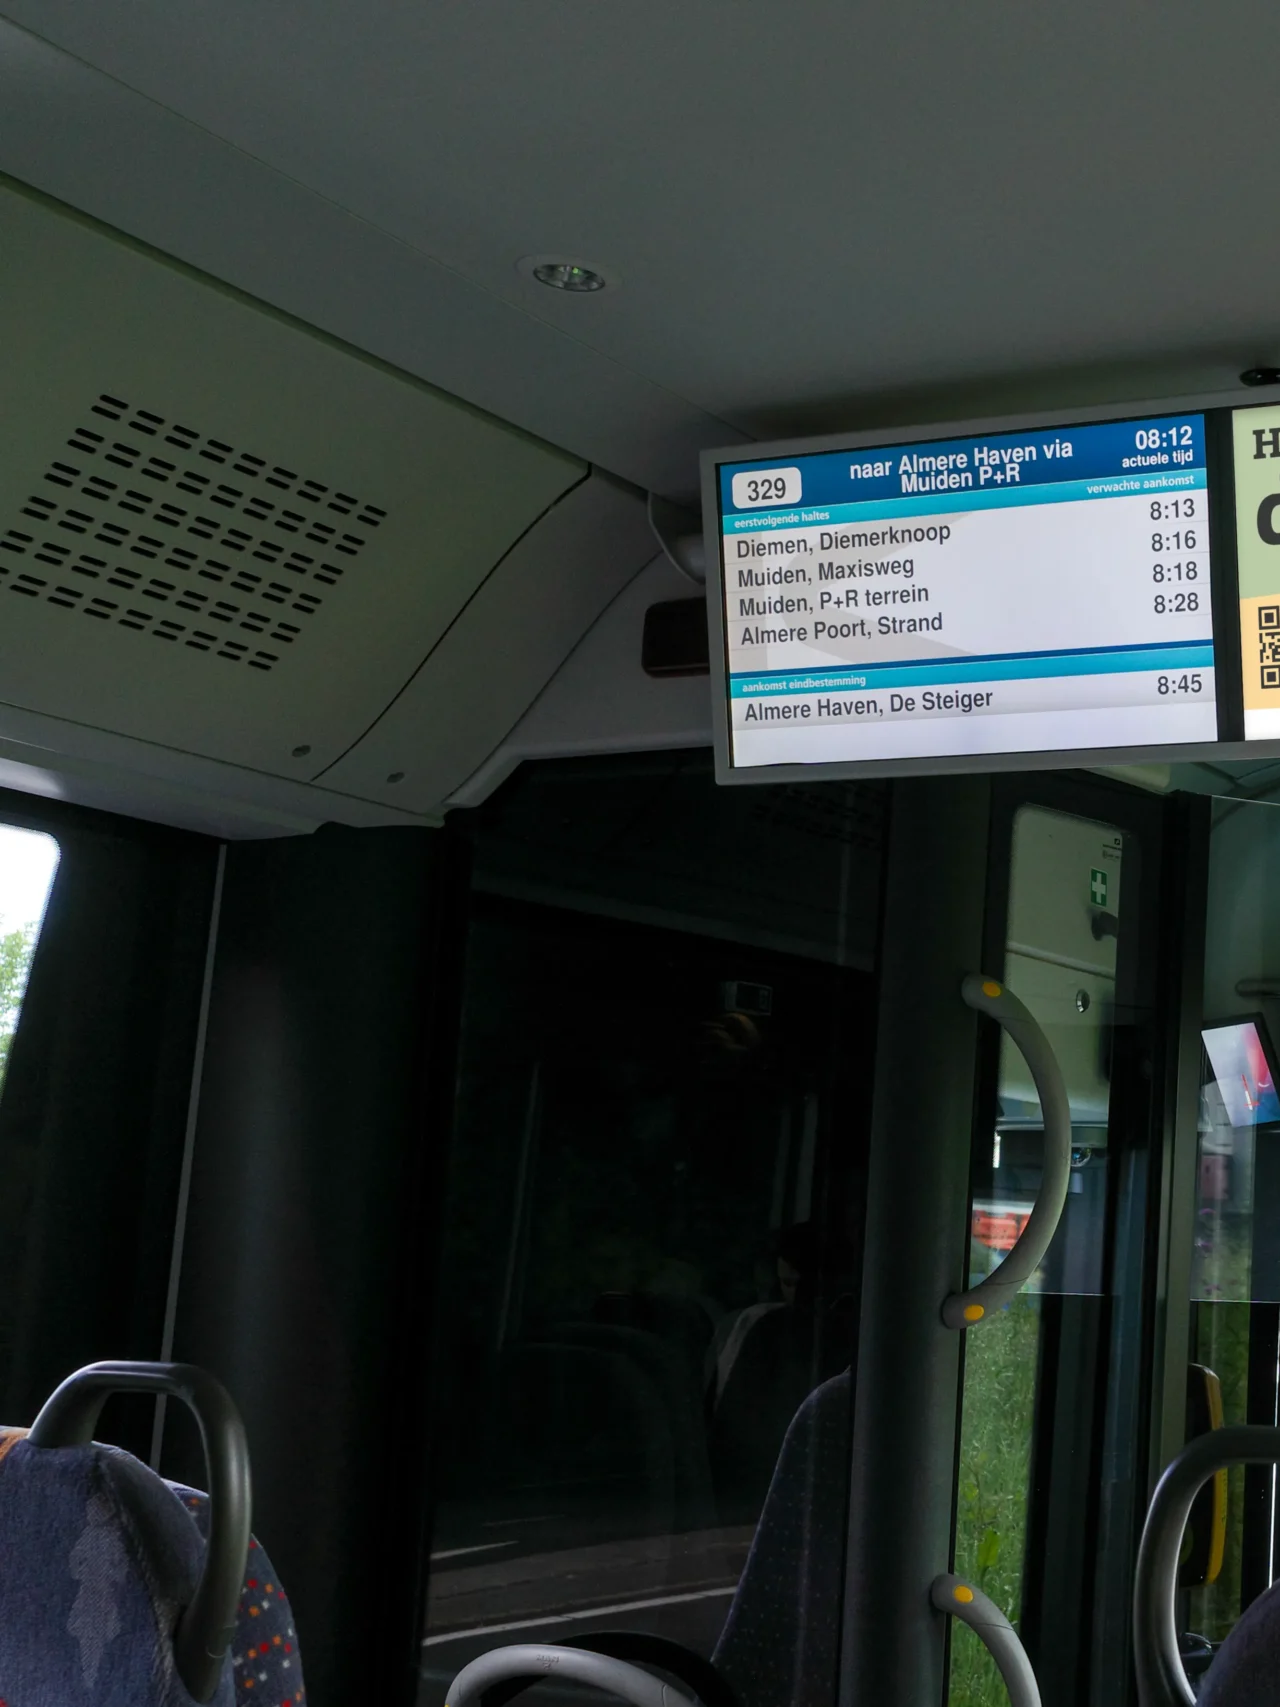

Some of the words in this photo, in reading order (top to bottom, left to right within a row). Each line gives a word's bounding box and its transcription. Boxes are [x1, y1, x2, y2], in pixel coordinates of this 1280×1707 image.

[1134, 425, 1194, 449] 08:12
[849, 459, 893, 481] naar
[899, 449, 969, 475] Almere
[973, 444, 1037, 470] Haven
[1042, 440, 1073, 460] via
[1121, 451, 1168, 469] actuele
[1171, 448, 1194, 466] tijd
[746, 477, 787, 502] 329
[900, 469, 973, 495] Muiden
[978, 463, 1021, 486] P+R
[1086, 478, 1140, 496] verwachte
[1142, 474, 1195, 489] aankomst
[734, 513, 800, 530] eerstvolgende
[801, 510, 830, 522] haltes
[1149, 498, 1196, 520] 8:13
[737, 536, 814, 560] Diemen,
[819, 523, 952, 552] Diemerknoop
[1150, 529, 1197, 552] 8:16
[737, 566, 813, 589] Muiden,
[818, 556, 916, 581] Maxisweg
[1152, 561, 1199, 583] 8:18
[739, 595, 814, 617] Muiden,
[819, 589, 860, 611] P+R
[864, 584, 930, 606] terrein
[1153, 592, 1200, 614] 8:28
[740, 623, 808, 646] Almere
[813, 618, 873, 641] Poort,
[877, 612, 944, 635] Strand
[742, 680, 787, 693] aankomst
[788, 673, 866, 691] eindbestemming
[1156, 673, 1203, 695] 8:45
[744, 699, 812, 722] Almere
[816, 695, 885, 719] Haven,
[889, 692, 916, 714] De
[921, 688, 994, 714] Steiger
